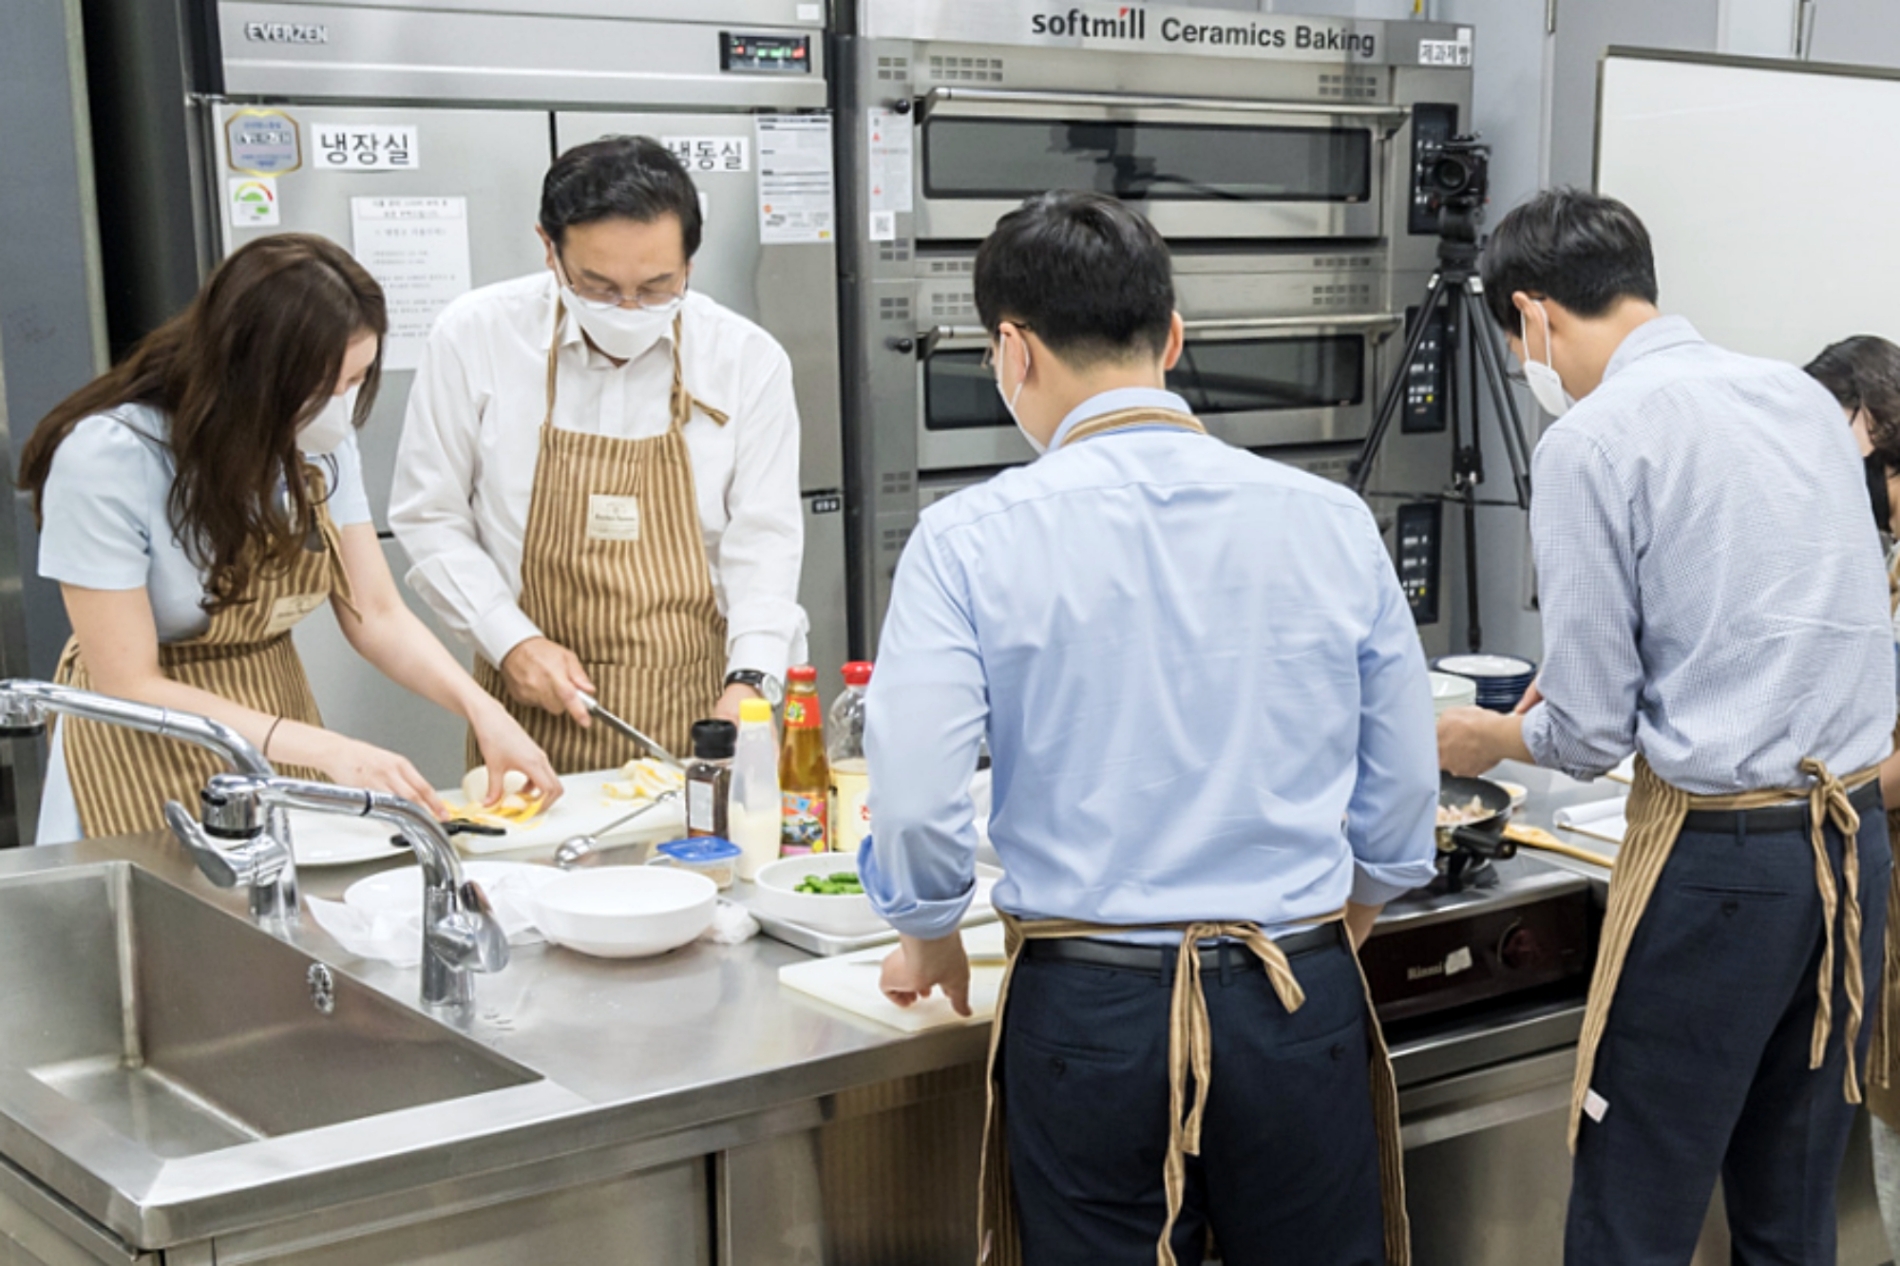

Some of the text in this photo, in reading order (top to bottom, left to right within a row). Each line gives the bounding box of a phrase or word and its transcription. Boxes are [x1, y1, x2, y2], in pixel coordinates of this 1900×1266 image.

[244, 22, 329, 43] EVERZEN
[1032, 7, 1375, 58] softmill Ceramics Baking
[321, 133, 411, 165] 냉장실
